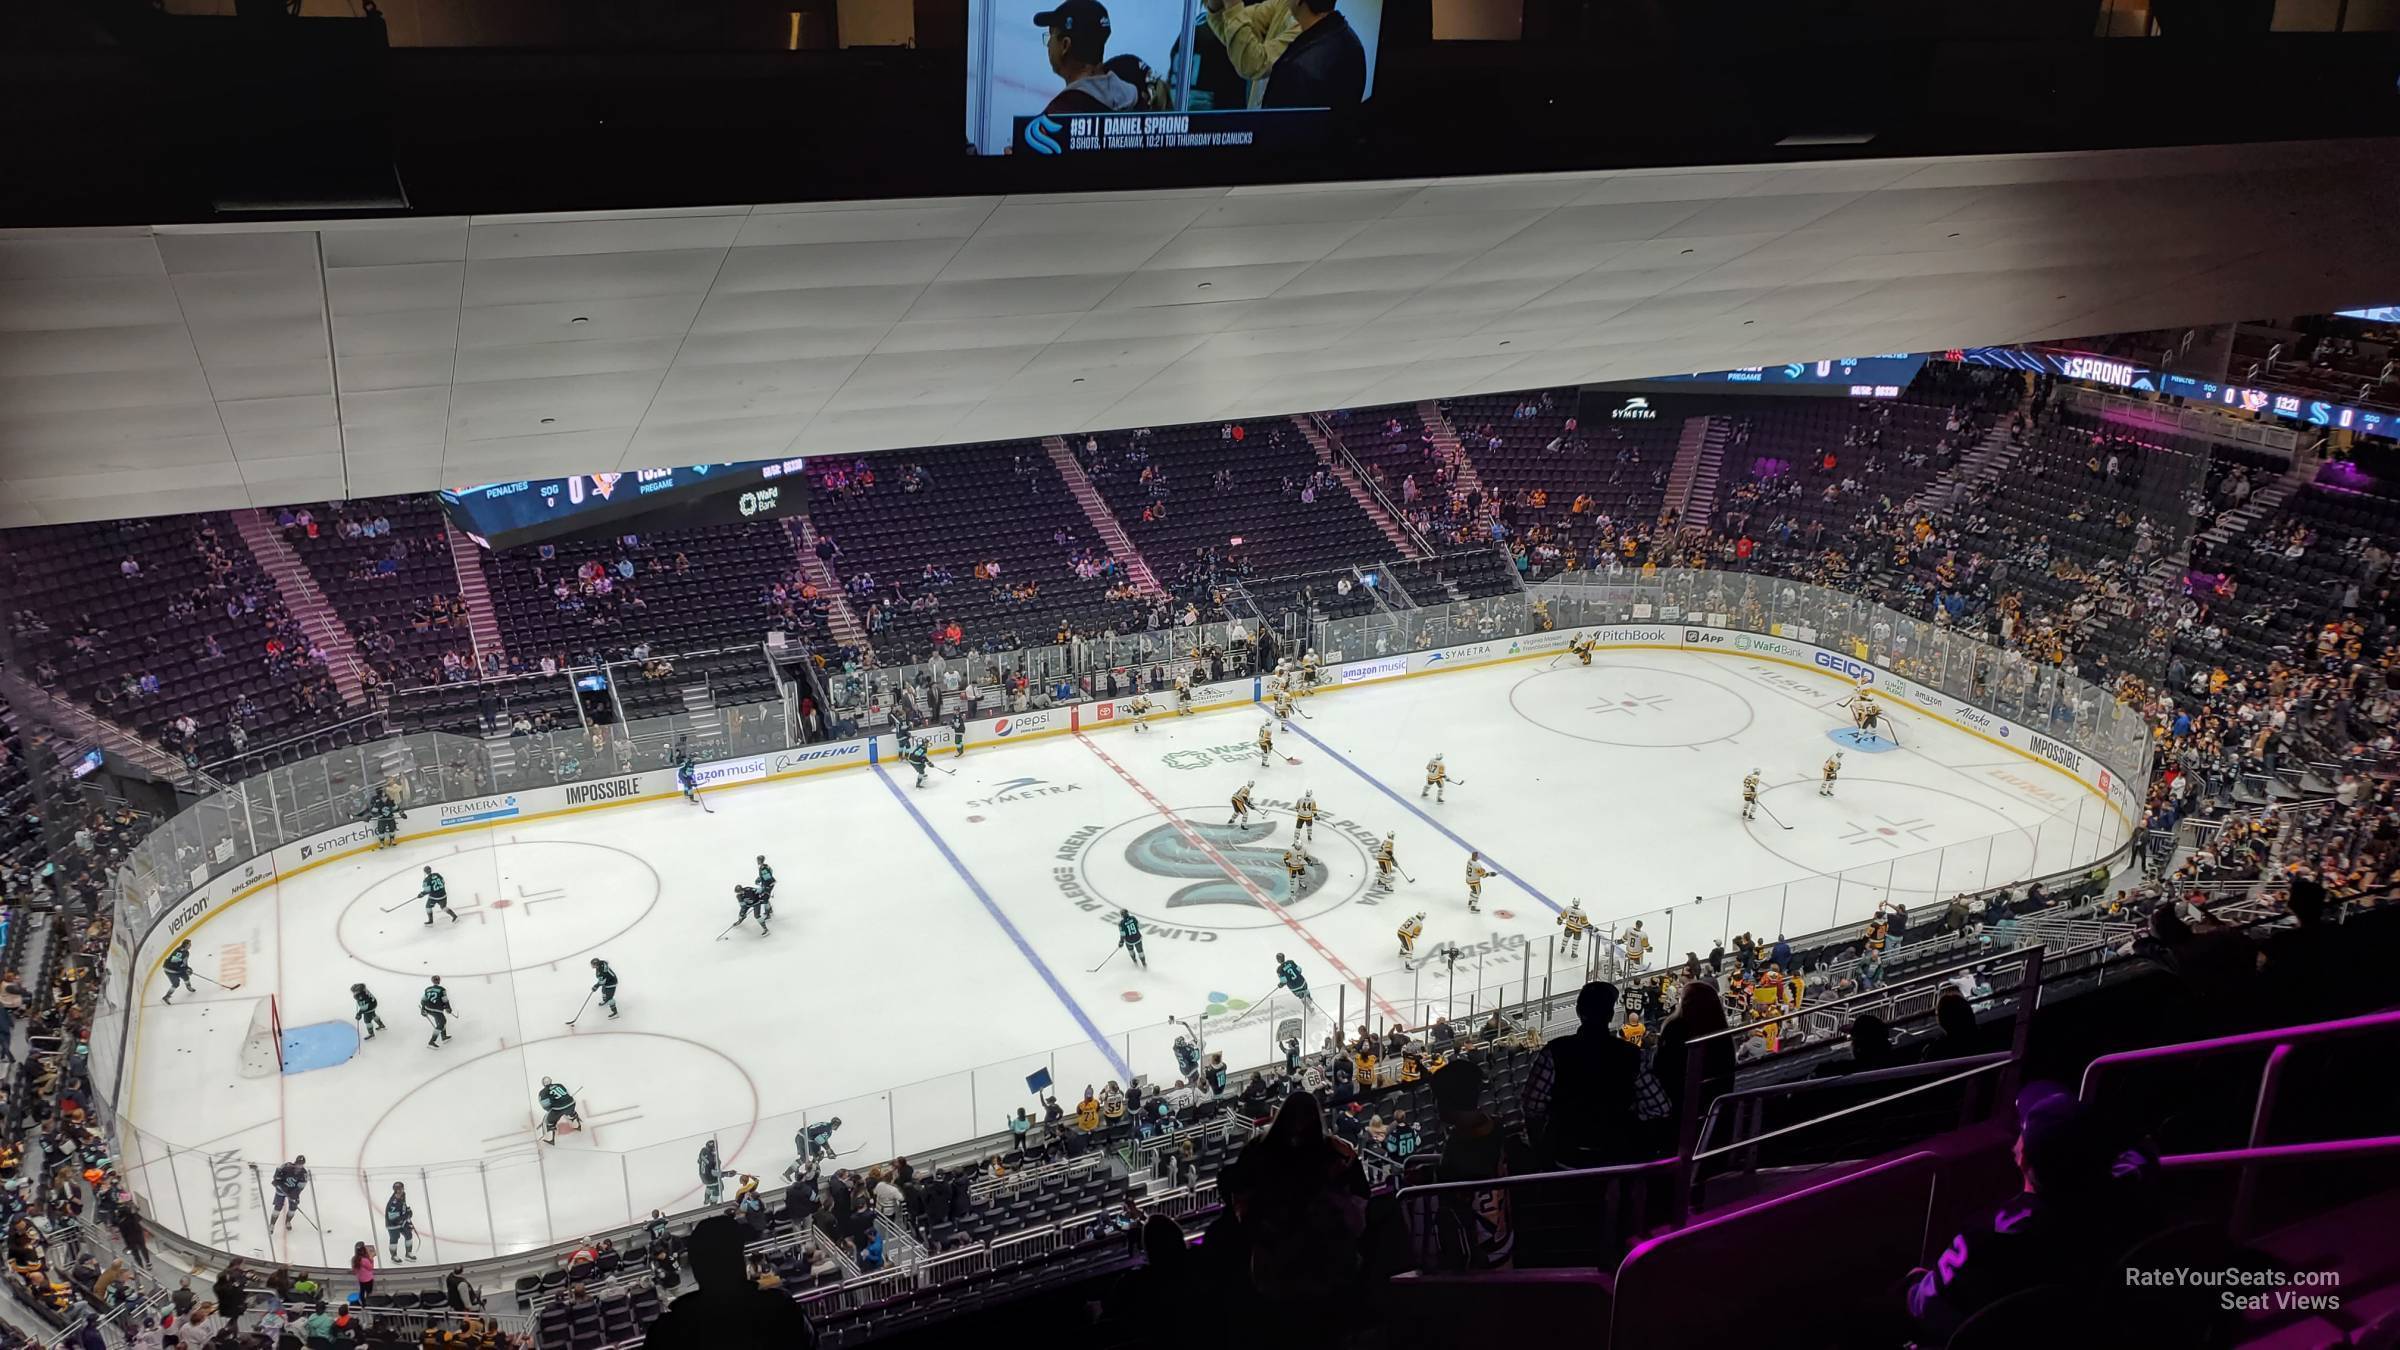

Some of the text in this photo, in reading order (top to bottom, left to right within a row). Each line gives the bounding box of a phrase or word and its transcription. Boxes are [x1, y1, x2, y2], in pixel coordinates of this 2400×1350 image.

[1071, 118, 1092, 136] #91
[1104, 117, 1142, 136] DANIEL
[1144, 115, 1189, 135] SPRONG
[1070, 137, 1076, 149] 3
[1076, 136, 1101, 150] SHOTS,
[1108, 135, 1144, 150] TAKEAWAY,
[1165, 134, 1176, 147] TOI
[1177, 133, 1211, 147] THURSDAY
[1212, 132, 1221, 145] VS
[1222, 131, 1253, 145] CANUCKS
[1727, 373, 1762, 382] PREGAME
[2069, 357, 2133, 387] SPRONG
[2224, 388, 2235, 404] 0
[1611, 408, 1656, 419] SYMETRA
[2340, 409, 2352, 427] 0
[486, 481, 529, 499] PENALTIES
[540, 484, 559, 497] SOG
[568, 475, 584, 505] 0
[640, 479, 675, 495] PREGAME
[755, 487, 779, 502] WaFd
[547, 497, 554, 508] 0
[758, 500, 777, 512] Bank
[1602, 629, 1665, 641] PitchBook
[1445, 646, 1491, 659] SYMETRA
[1343, 659, 1406, 679] amazon music
[1815, 652, 1875, 684] GEICO
[1915, 690, 1942, 707] amazon
[1015, 711, 1050, 730] pepsi
[1955, 706, 1991, 727] Alaska
[797, 744, 861, 762] BOEING
[2029, 735, 2081, 774] IMPOSSIBLE
[727, 760, 765, 776] music
[566, 777, 640, 806] IMPOSSIBLE
[966, 782, 1082, 809] SYMETRA
[441, 798, 498, 817] PREMERA
[1302, 801, 1312, 812] 44
[1056, 825, 1105, 862] ARENA
[1053, 866, 1103, 912] PLEDGE
[168, 897, 208, 936] verizon
[1126, 923, 1137, 936] 19
[1625, 998, 1642, 1011] 66
[1308, 1074, 1321, 1087] 66
[1107, 1101, 1122, 1113] 59
[1399, 1138, 1415, 1156] 60
[211, 1148, 242, 1246] FILSON
